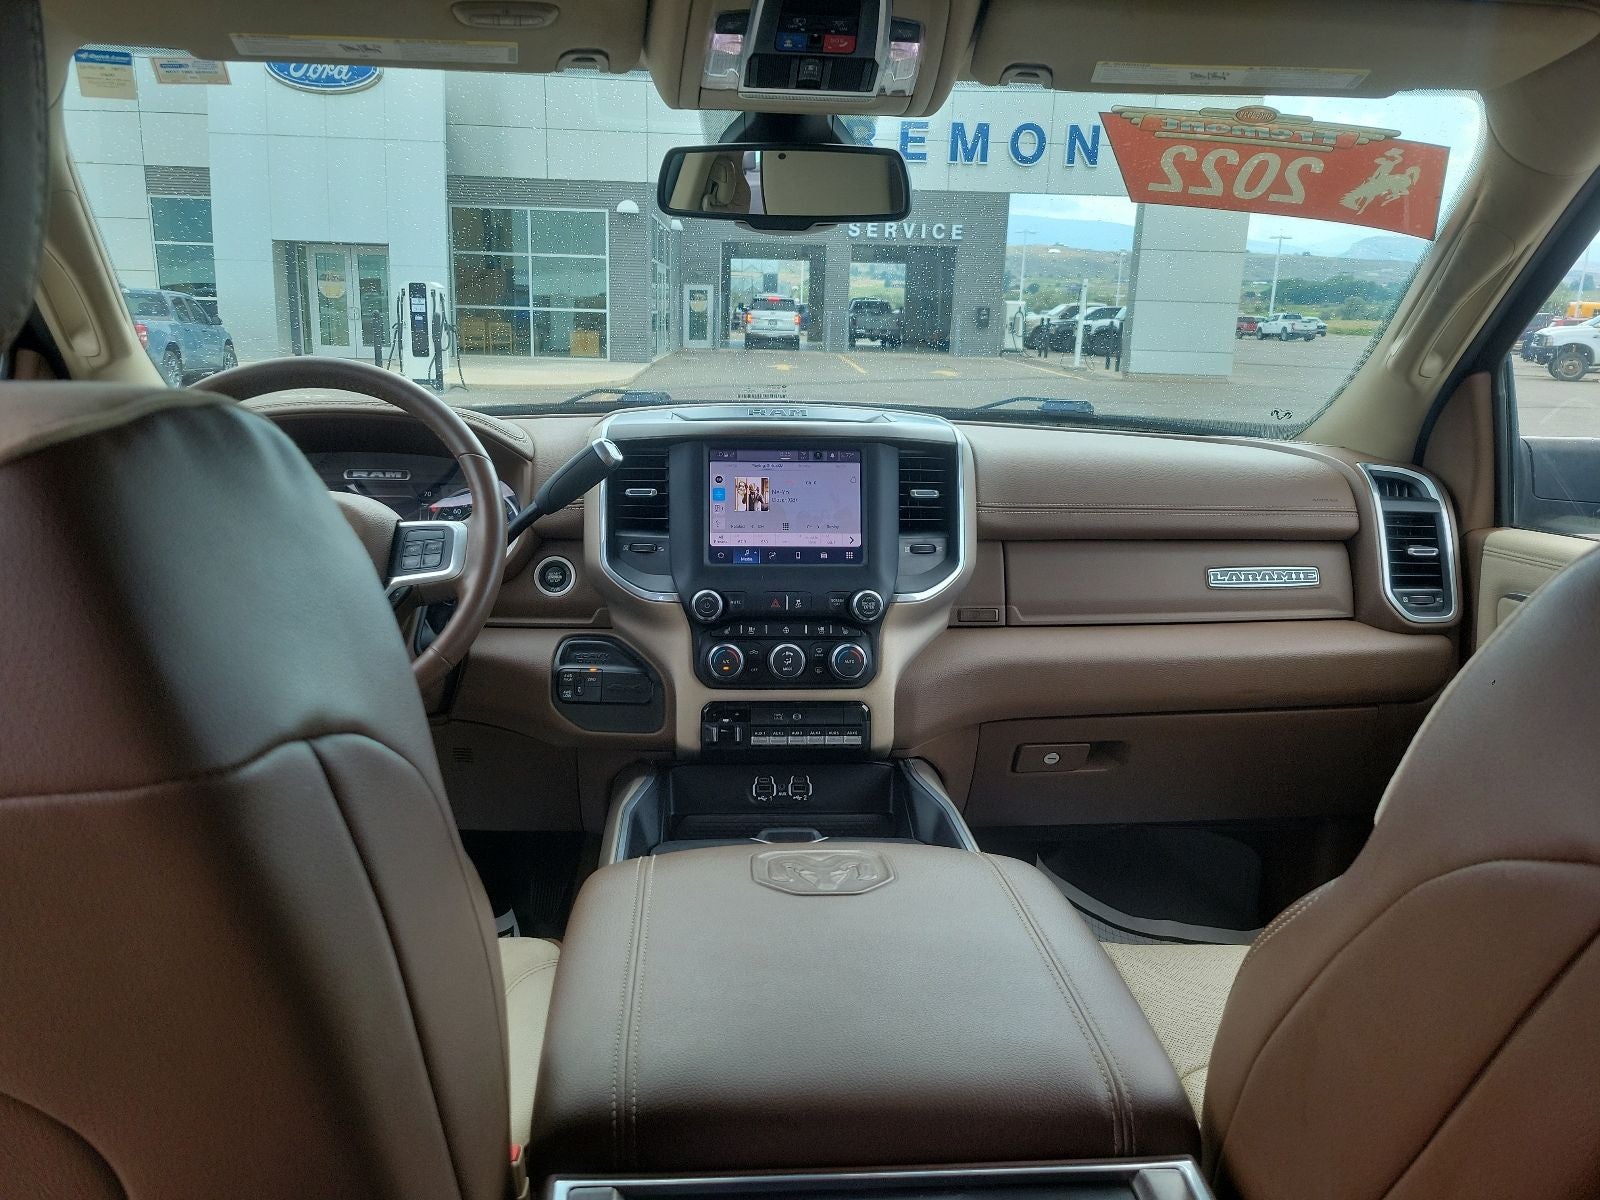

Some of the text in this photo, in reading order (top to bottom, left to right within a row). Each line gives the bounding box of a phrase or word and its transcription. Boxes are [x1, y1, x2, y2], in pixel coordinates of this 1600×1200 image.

[847, 222, 965, 240] SERVICE
[748, 408, 808, 416] RAM
[1211, 570, 1317, 582] LARAMIE
